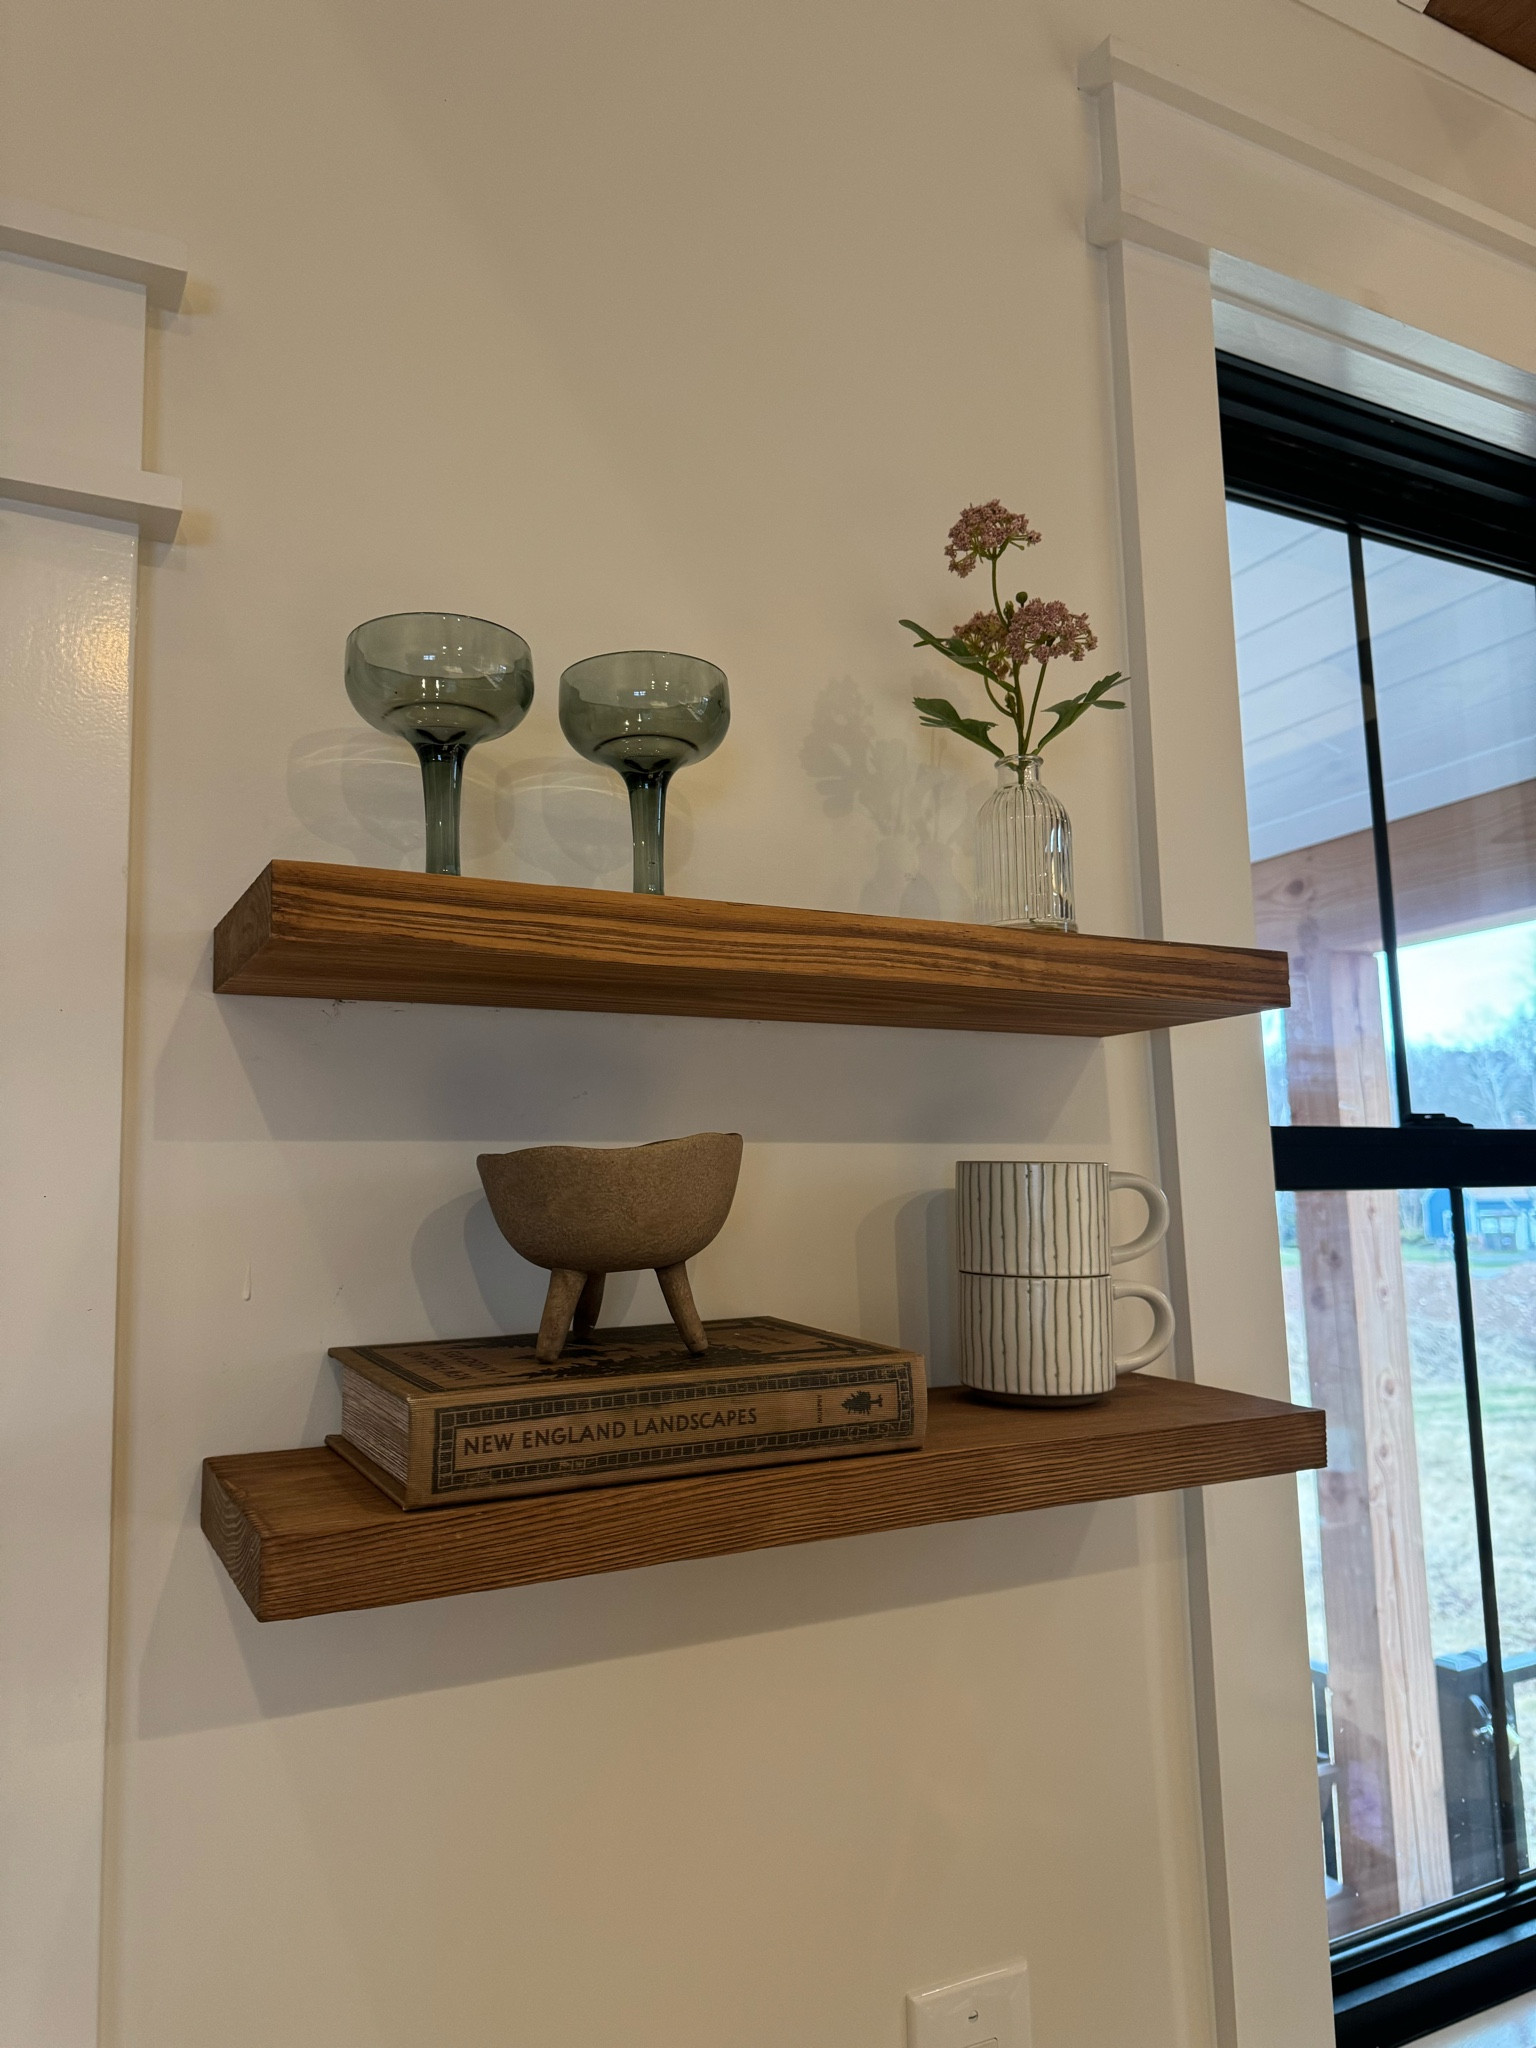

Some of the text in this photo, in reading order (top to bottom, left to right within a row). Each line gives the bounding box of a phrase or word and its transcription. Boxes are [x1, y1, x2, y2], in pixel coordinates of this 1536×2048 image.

[463, 1408, 757, 1456] NEW ENGLAND LANDSCAPES
